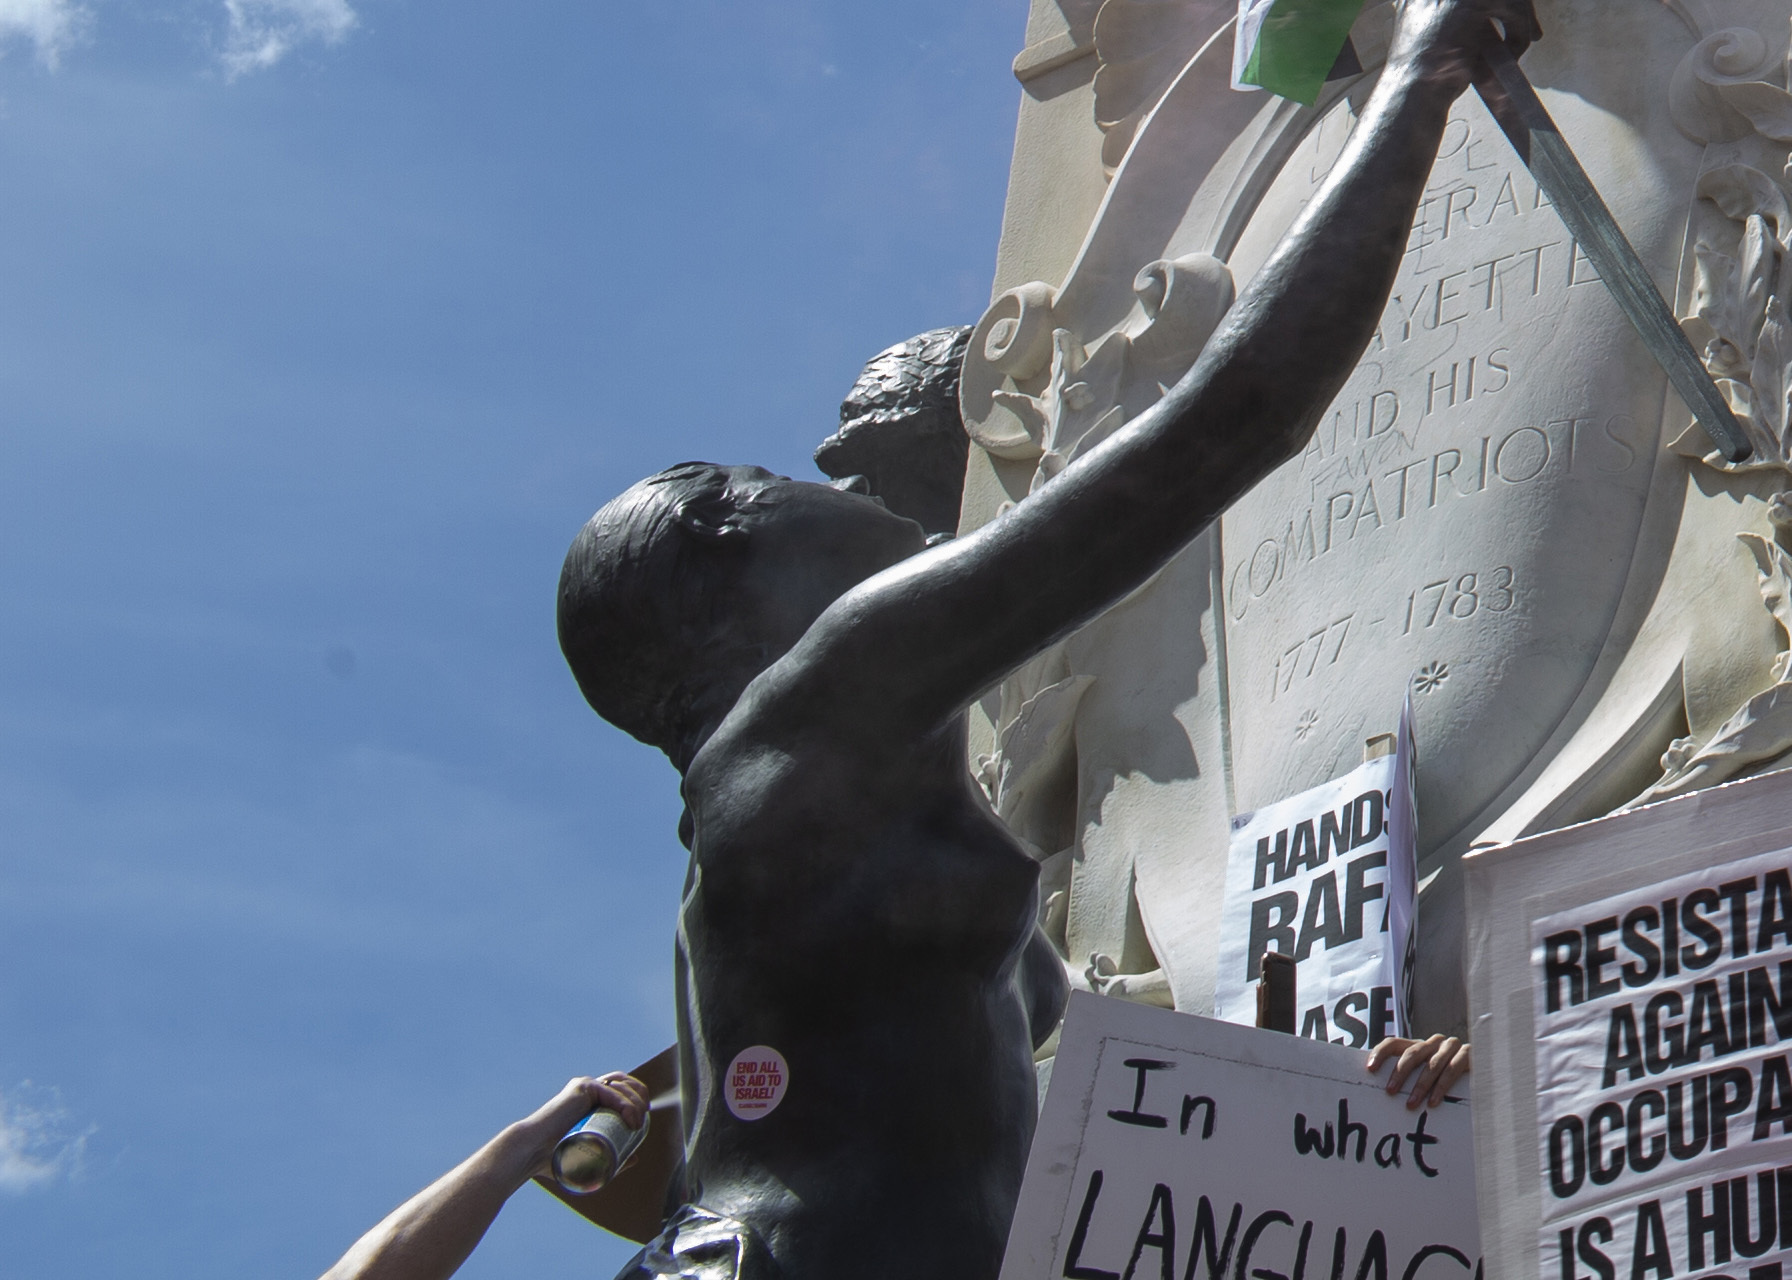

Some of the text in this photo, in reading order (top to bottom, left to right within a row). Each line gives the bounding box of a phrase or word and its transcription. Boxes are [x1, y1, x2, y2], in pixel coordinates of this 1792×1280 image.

[1302, 348, 1510, 471] AND HIS
[1230, 413, 1637, 621] COMPATRIOTS
[1271, 611, 1356, 703] 1777
[1404, 565, 1514, 636] 1783
[1252, 788, 1391, 891] HAND
[1246, 850, 1390, 983] RAF
[733, 1074, 781, 1087] US AID TO
[735, 1087, 775, 1100] ISRAEL!
[737, 1061, 779, 1074] END ALL
[1107, 1058, 1439, 1178] In what
[1558, 1216, 1615, 1280] IS
[1632, 1199, 1673, 1280] A
